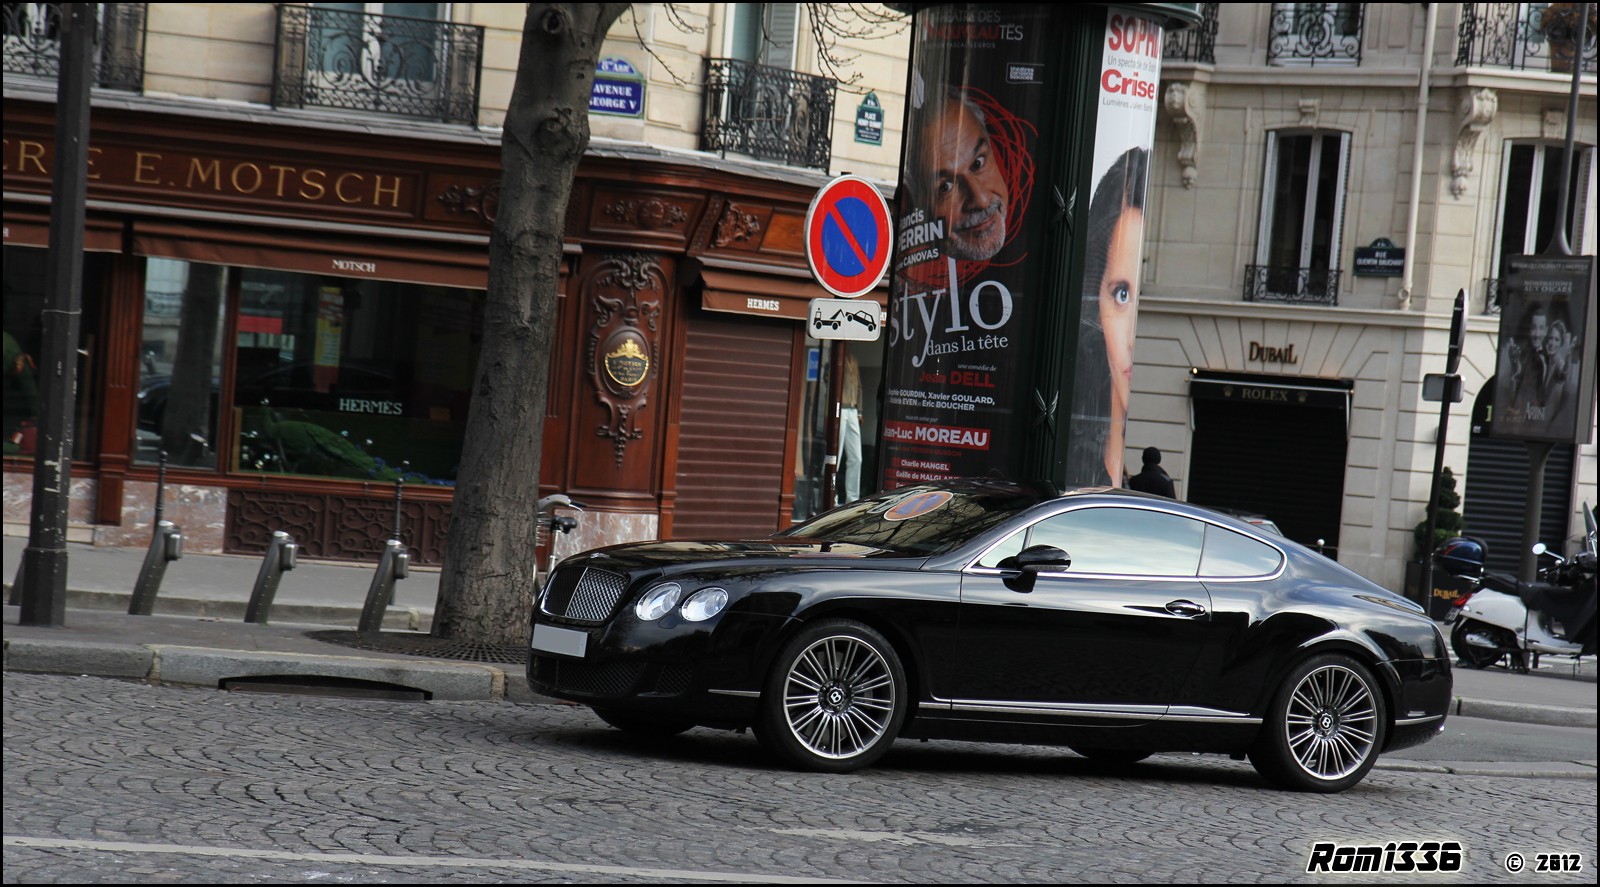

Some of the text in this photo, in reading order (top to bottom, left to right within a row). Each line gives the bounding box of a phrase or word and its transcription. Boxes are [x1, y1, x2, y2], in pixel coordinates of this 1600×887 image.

[978, 10, 1000, 22] DES
[1108, 56, 1116, 66] Un
[593, 84, 632, 96] AVENUE
[1102, 69, 1155, 100] Crise
[629, 100, 637, 110] V
[904, 248, 939, 266] CANOVAS
[332, 259, 376, 273] MOTSCH
[890, 256, 1013, 368] stylo
[927, 334, 1008, 356] dans la tête
[1249, 341, 1298, 364] DUBAIL
[920, 370, 995, 388] Jean DELL
[928, 392, 950, 401] Xavier
[952, 394, 995, 405] GOULARD,
[1242, 388, 1288, 402] ROLEX
[936, 401, 975, 411] BOUCHER
[915, 426, 987, 446] MOREAU
[901, 460, 949, 471] Charlie MANGEL
[1433, 588, 1460, 600] DUBAIL
